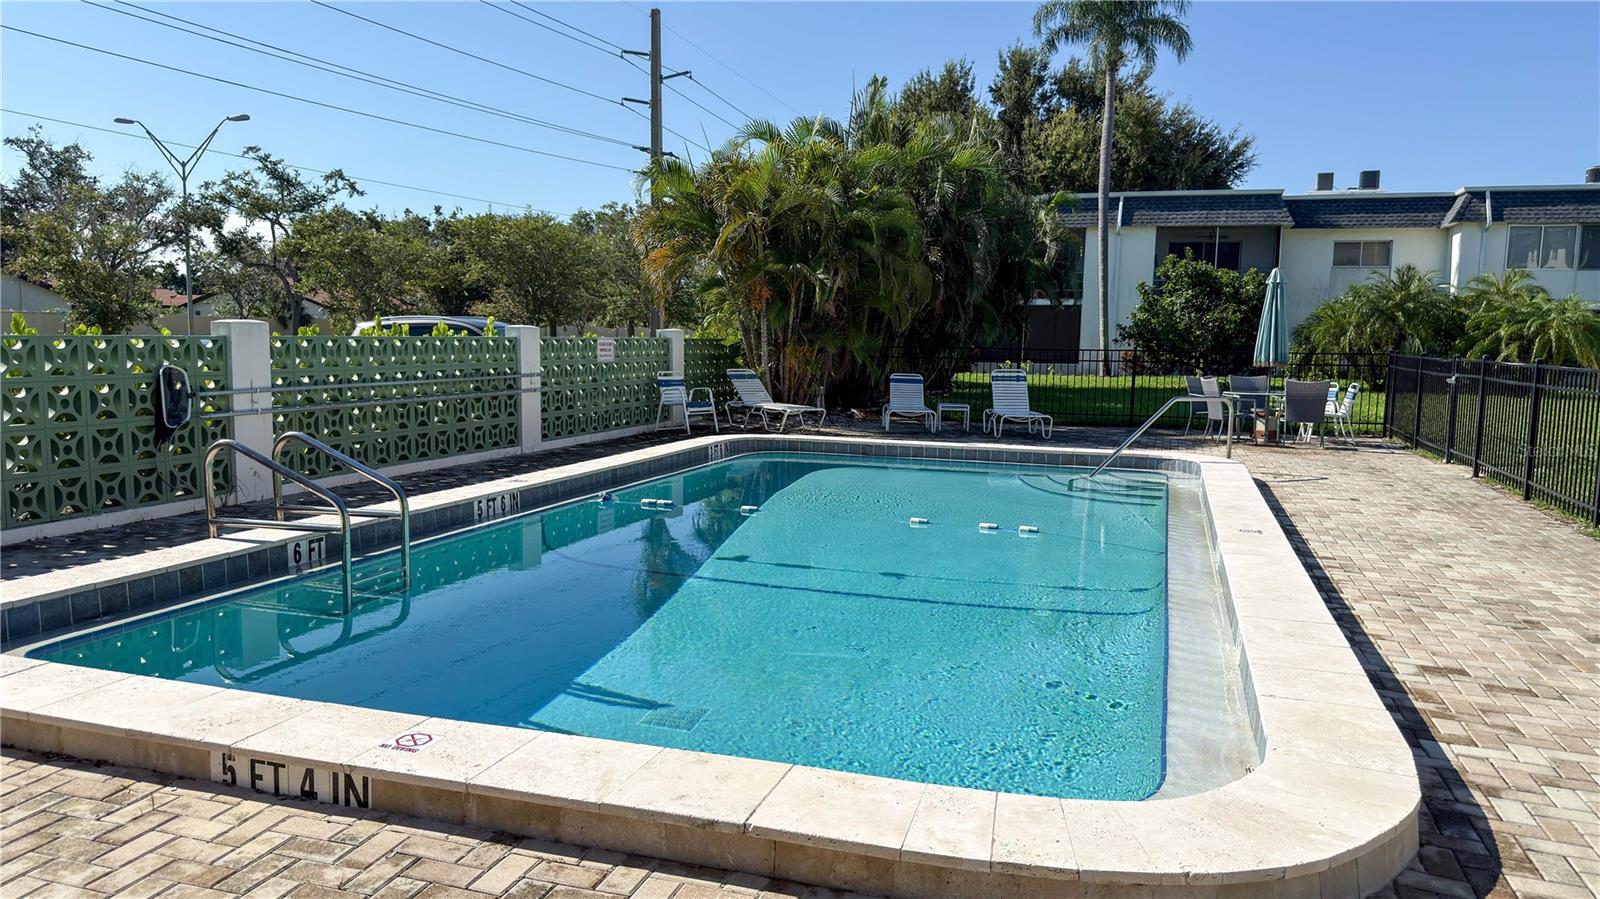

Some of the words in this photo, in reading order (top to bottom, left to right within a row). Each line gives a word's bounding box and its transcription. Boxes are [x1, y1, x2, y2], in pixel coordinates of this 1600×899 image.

[477, 500, 483, 518] 5
[487, 497, 497, 518] FT
[501, 495, 506, 512] 6
[509, 491, 519, 513] IN
[293, 542, 302, 565] 6
[308, 537, 324, 562] FT
[222, 752, 237, 786] 5
[250, 758, 287, 796] FT
[300, 767, 318, 801] 4
[332, 771, 369, 809] IN
